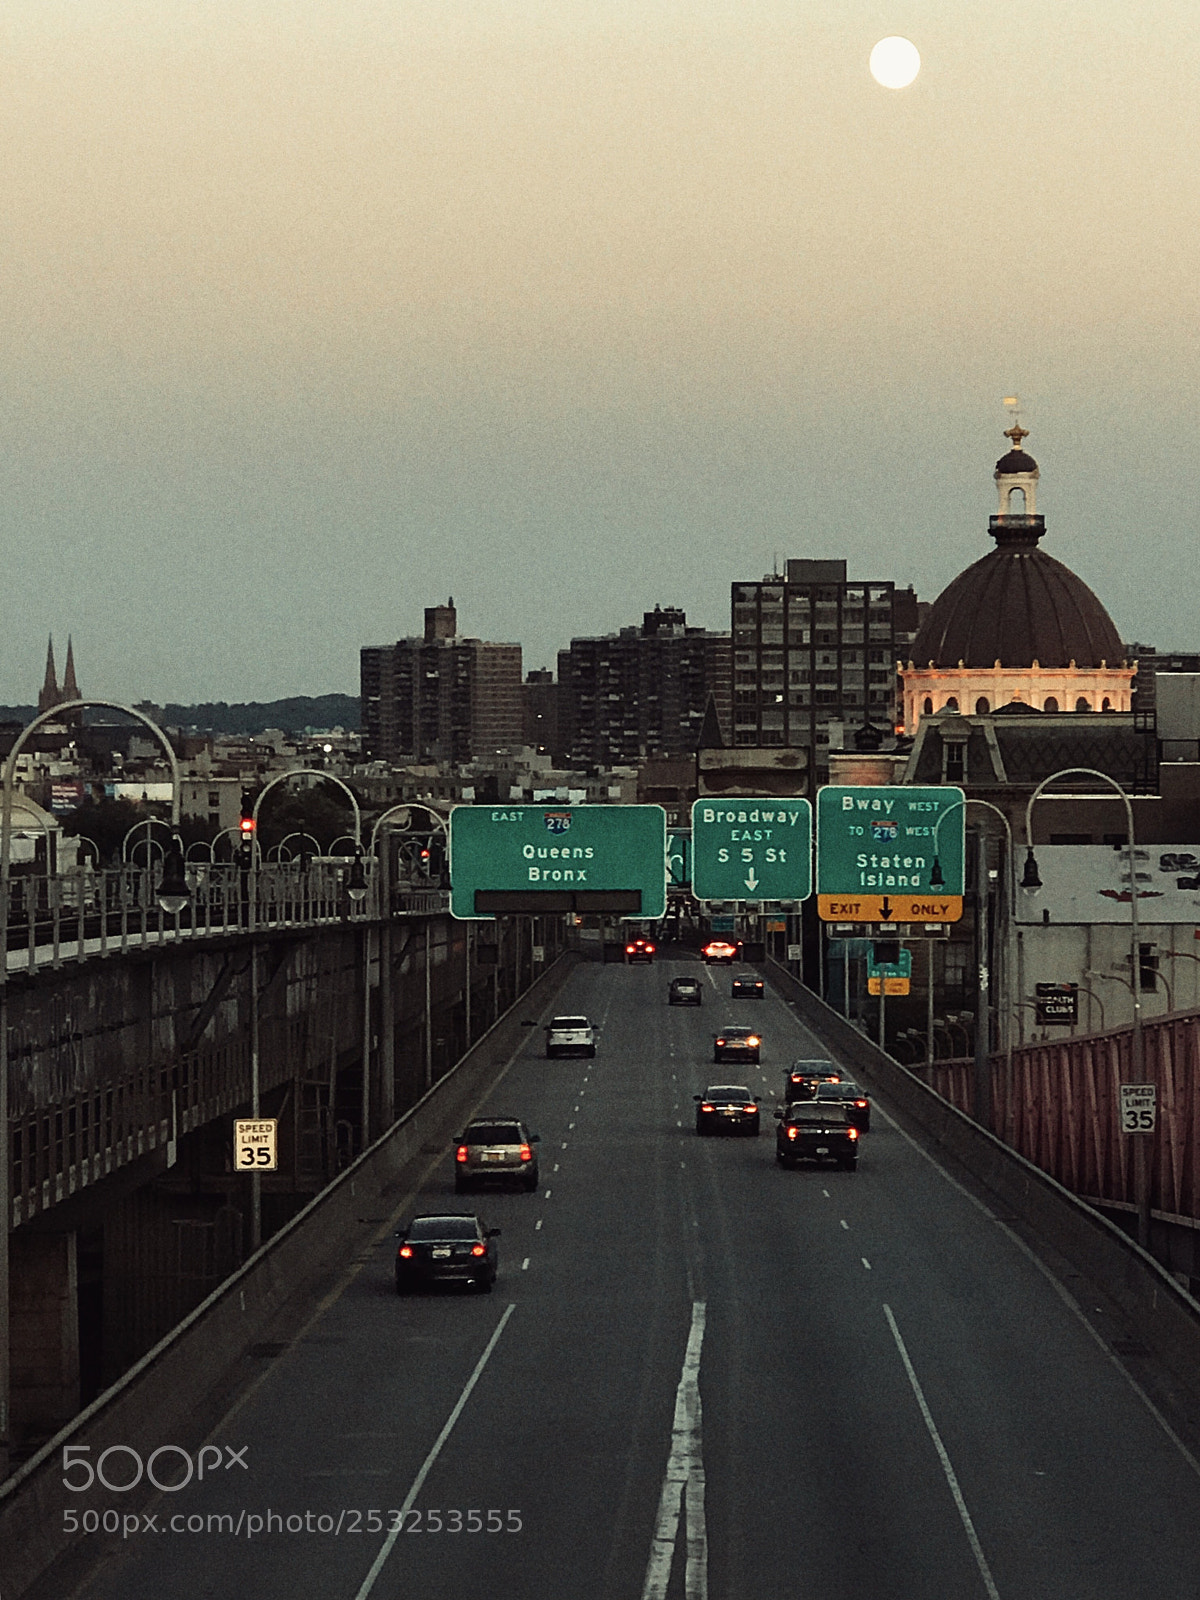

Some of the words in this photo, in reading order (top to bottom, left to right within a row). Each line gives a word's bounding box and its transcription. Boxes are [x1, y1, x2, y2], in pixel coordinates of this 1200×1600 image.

[842, 796, 894, 815] Bway
[908, 802, 939, 812] WEST
[491, 812, 524, 822] EAST
[703, 809, 799, 827] Broadway
[547, 818, 571, 830] 278
[731, 830, 772, 841] EAST
[849, 826, 864, 836] TO
[873, 826, 897, 839] 278
[905, 826, 935, 836] WEST
[522, 845, 594, 859] Queens
[718, 848, 729, 862] S
[741, 848, 753, 862] 5
[765, 848, 787, 863] St
[856, 854, 926, 869] Staten
[528, 867, 587, 881] Bronx
[860, 871, 921, 887] Island
[830, 903, 861, 915] EXIT
[911, 904, 949, 915] ONLY
[1122, 1087, 1154, 1097] SPEED
[1125, 1098, 1151, 1108] LIMIT
[1125, 1110, 1154, 1129] 35
[239, 1124, 273, 1134] SPEED
[241, 1135, 269, 1144] LIMIT
[240, 1147, 271, 1166] 35
